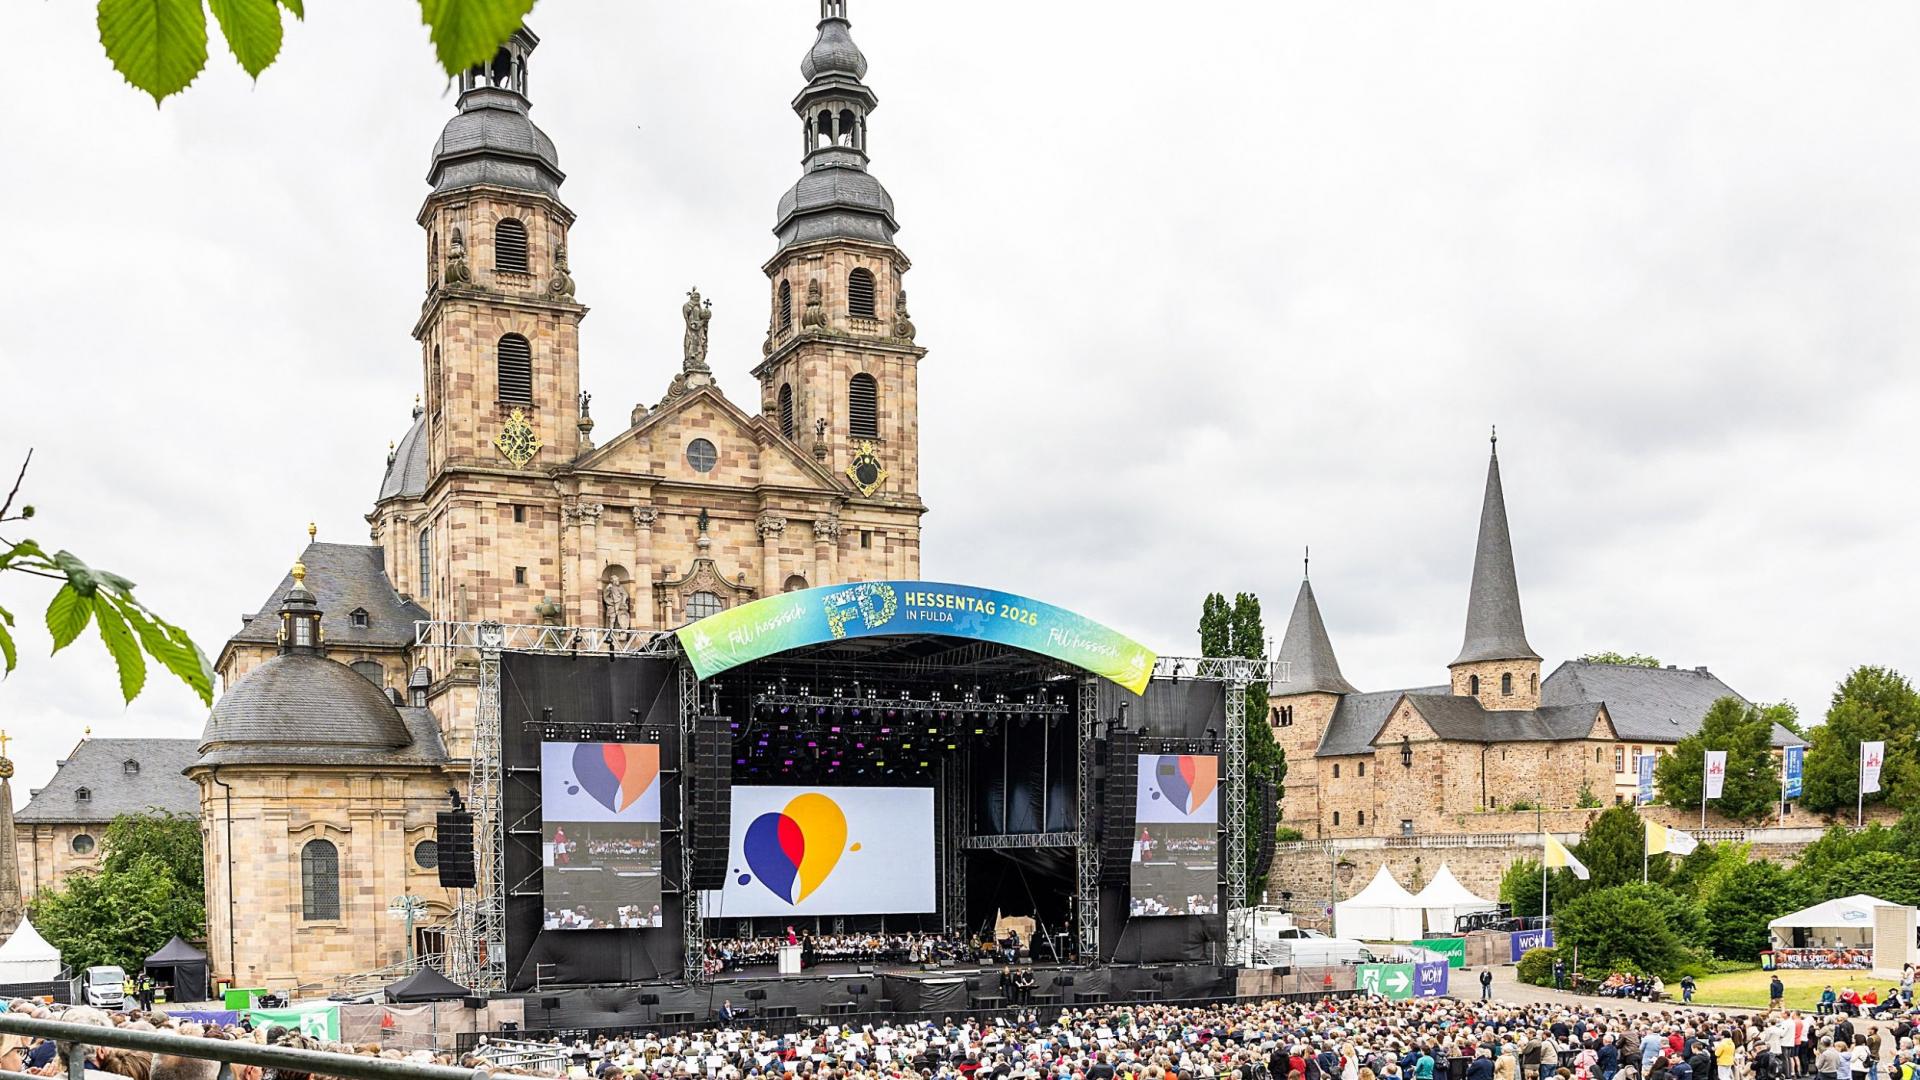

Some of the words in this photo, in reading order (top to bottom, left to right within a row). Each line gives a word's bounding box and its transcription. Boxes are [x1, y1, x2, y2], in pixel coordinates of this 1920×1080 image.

[822, 582, 898, 639] FD
[905, 592, 995, 615] HESSENTAG
[1000, 604, 1038, 626] 2026
[906, 610, 917, 620] IN
[920, 610, 953, 622] FULDA
[1519, 937, 1534, 949] WC
[1421, 969, 1433, 982] WC
